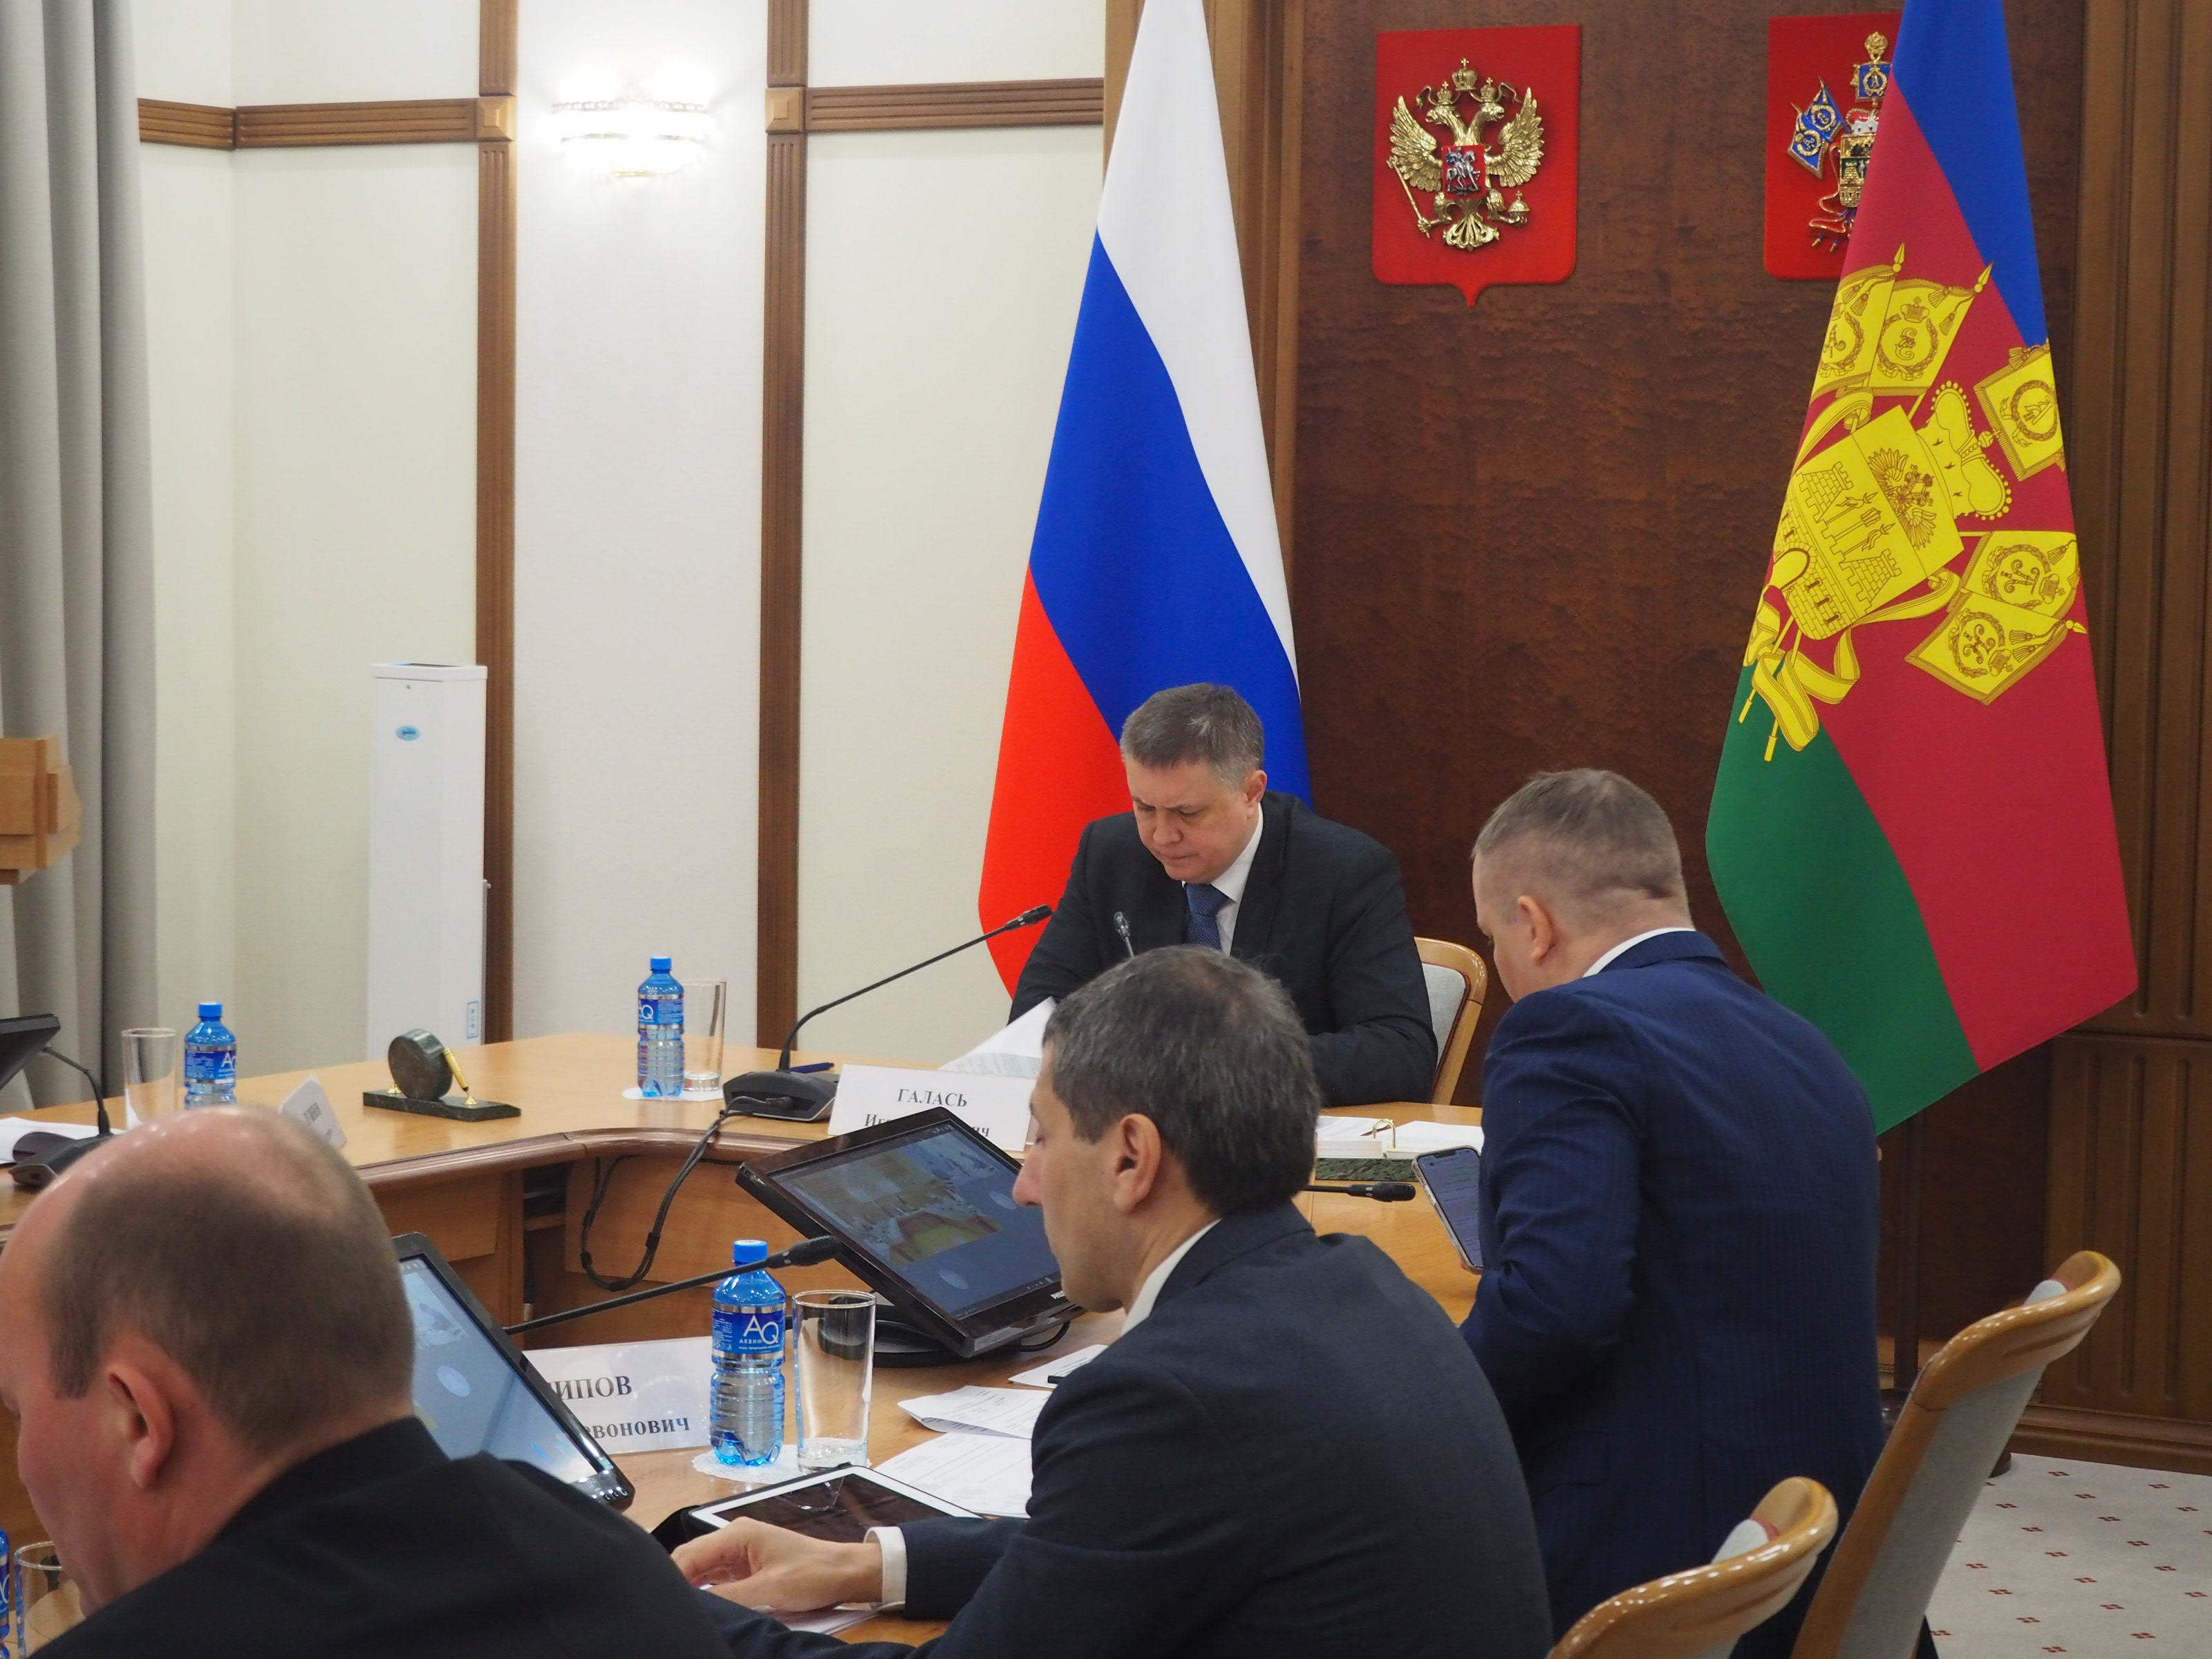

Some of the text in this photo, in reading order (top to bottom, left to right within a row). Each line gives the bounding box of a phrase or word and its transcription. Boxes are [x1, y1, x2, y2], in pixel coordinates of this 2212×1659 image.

[897, 1088, 968, 1107] ГАЛАСЬ
[743, 1315, 779, 1344] AQ
[550, 1376, 632, 1400] ИПОВ
